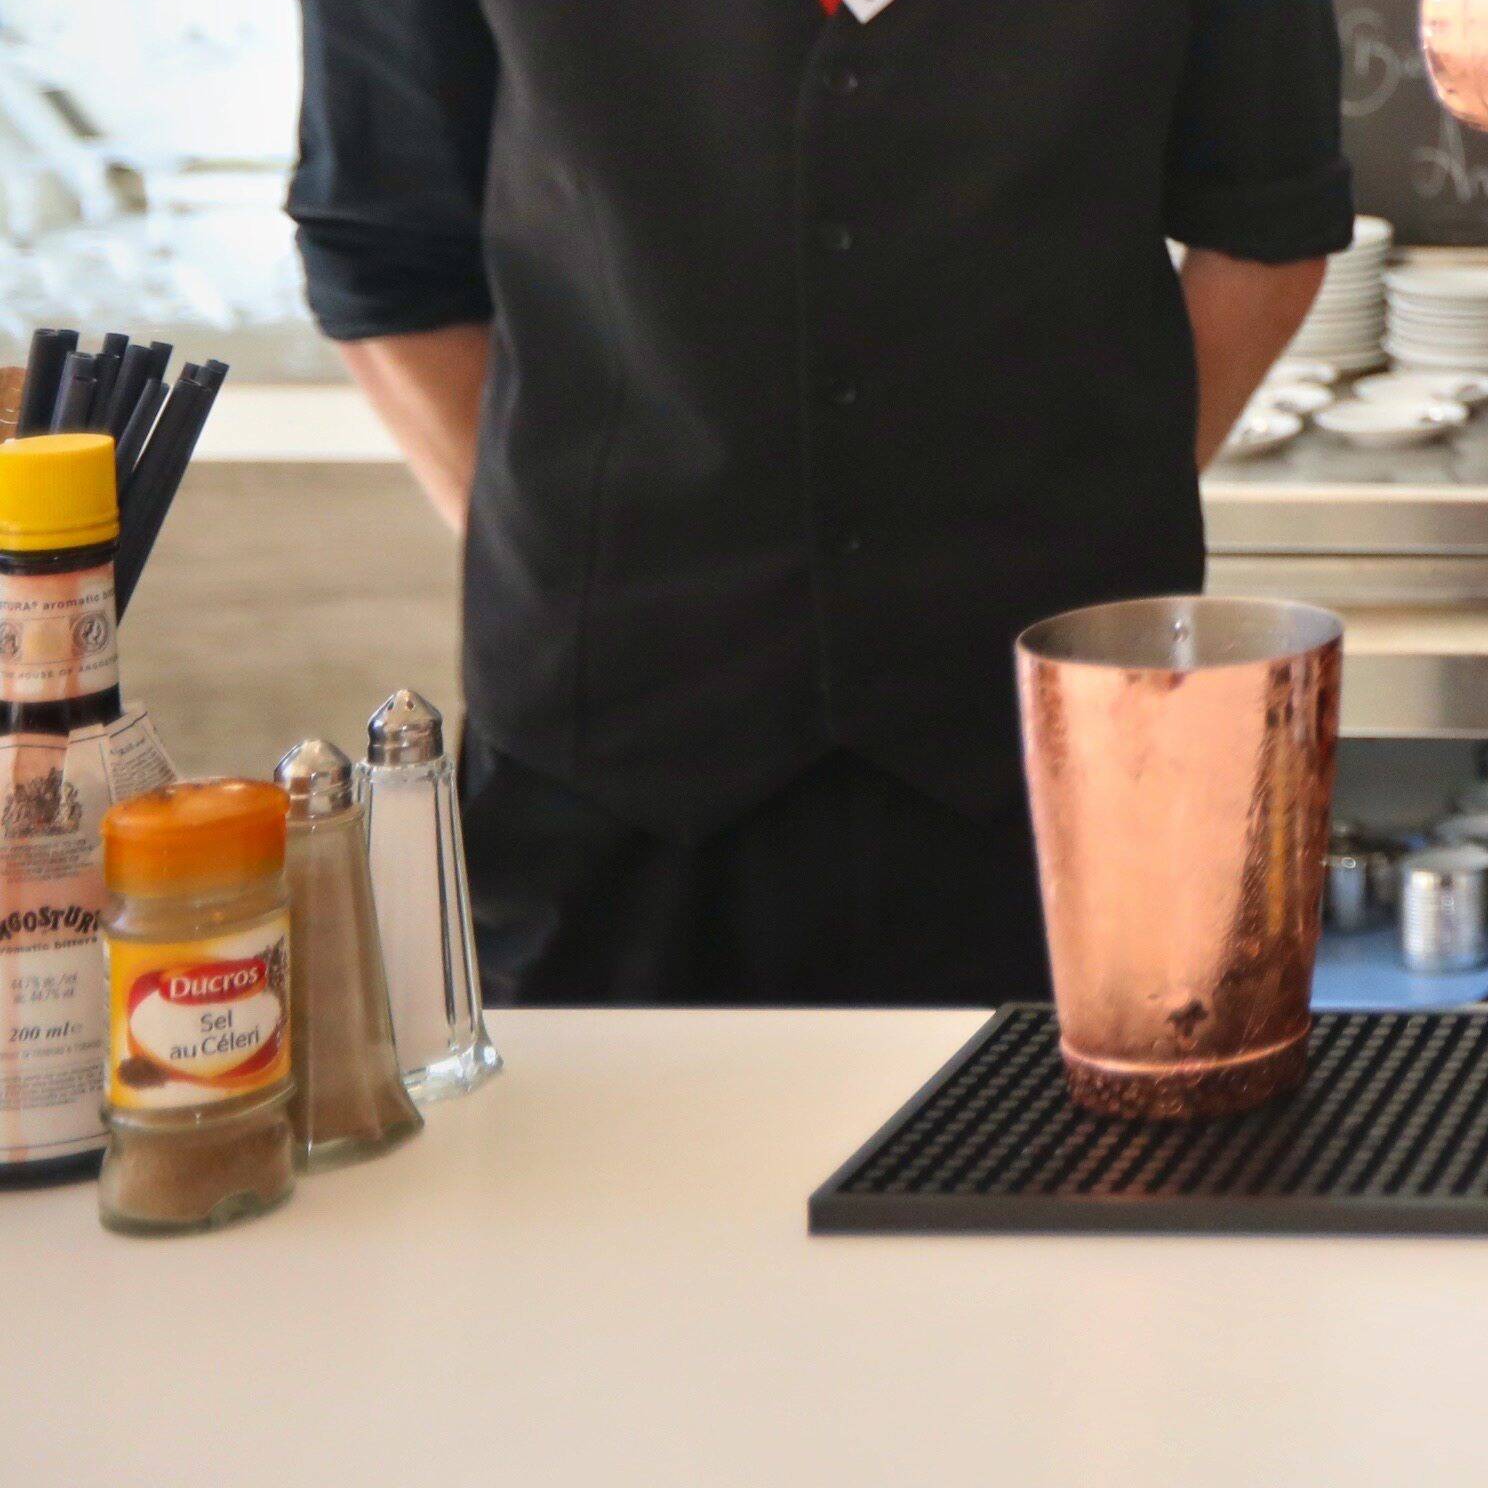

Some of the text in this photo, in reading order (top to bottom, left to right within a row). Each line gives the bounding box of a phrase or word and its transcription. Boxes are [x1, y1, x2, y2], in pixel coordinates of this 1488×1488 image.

[168, 965, 260, 1000] Ducros
[8, 1026, 41, 1042] 200
[200, 1009, 233, 1034] Sel
[169, 1024, 260, 1060] au Céleri
